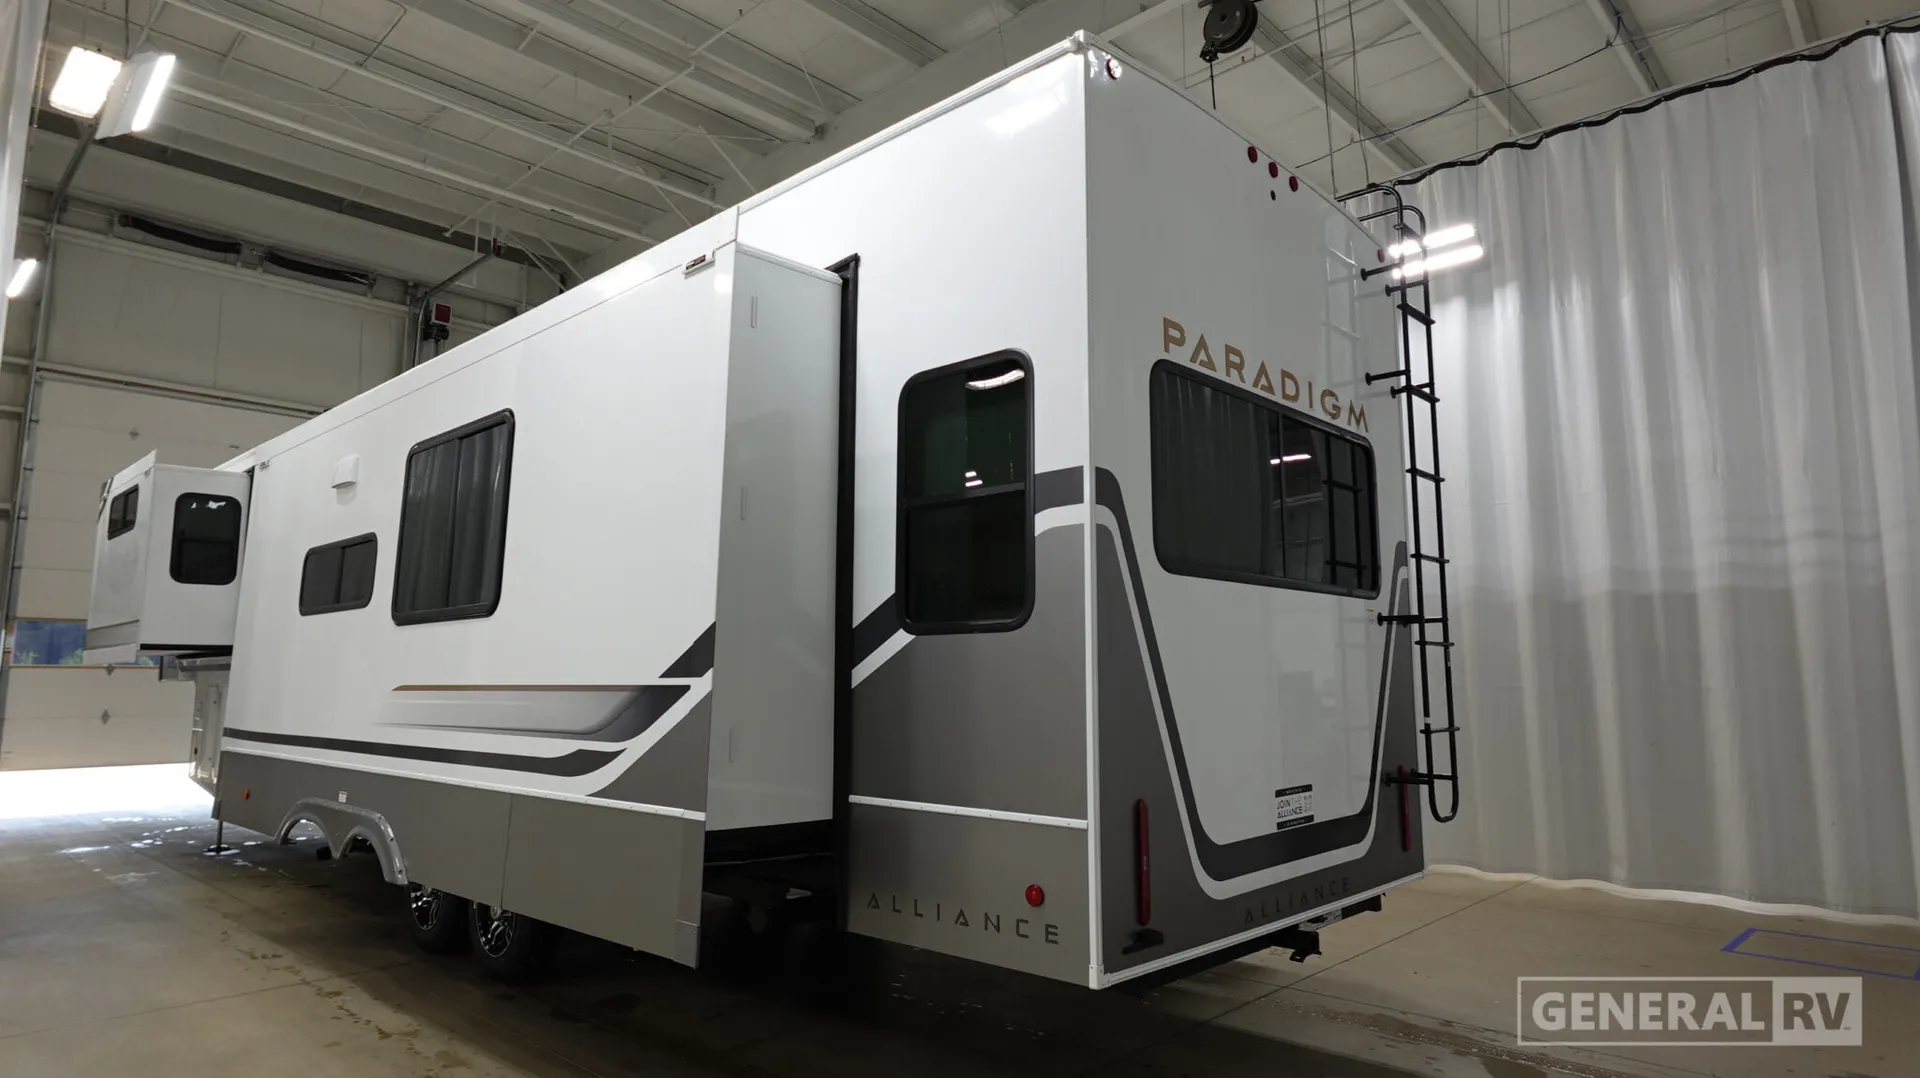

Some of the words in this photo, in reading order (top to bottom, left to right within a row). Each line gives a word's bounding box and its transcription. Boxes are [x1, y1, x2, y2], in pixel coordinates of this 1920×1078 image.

[1163, 317, 1369, 433] PARADIGM
[1277, 798, 1291, 809] JOIN
[1277, 806, 1303, 818] ALLIANCE
[867, 893, 1059, 944] ALLIANCE
[1244, 877, 1351, 925] ALLIANCE
